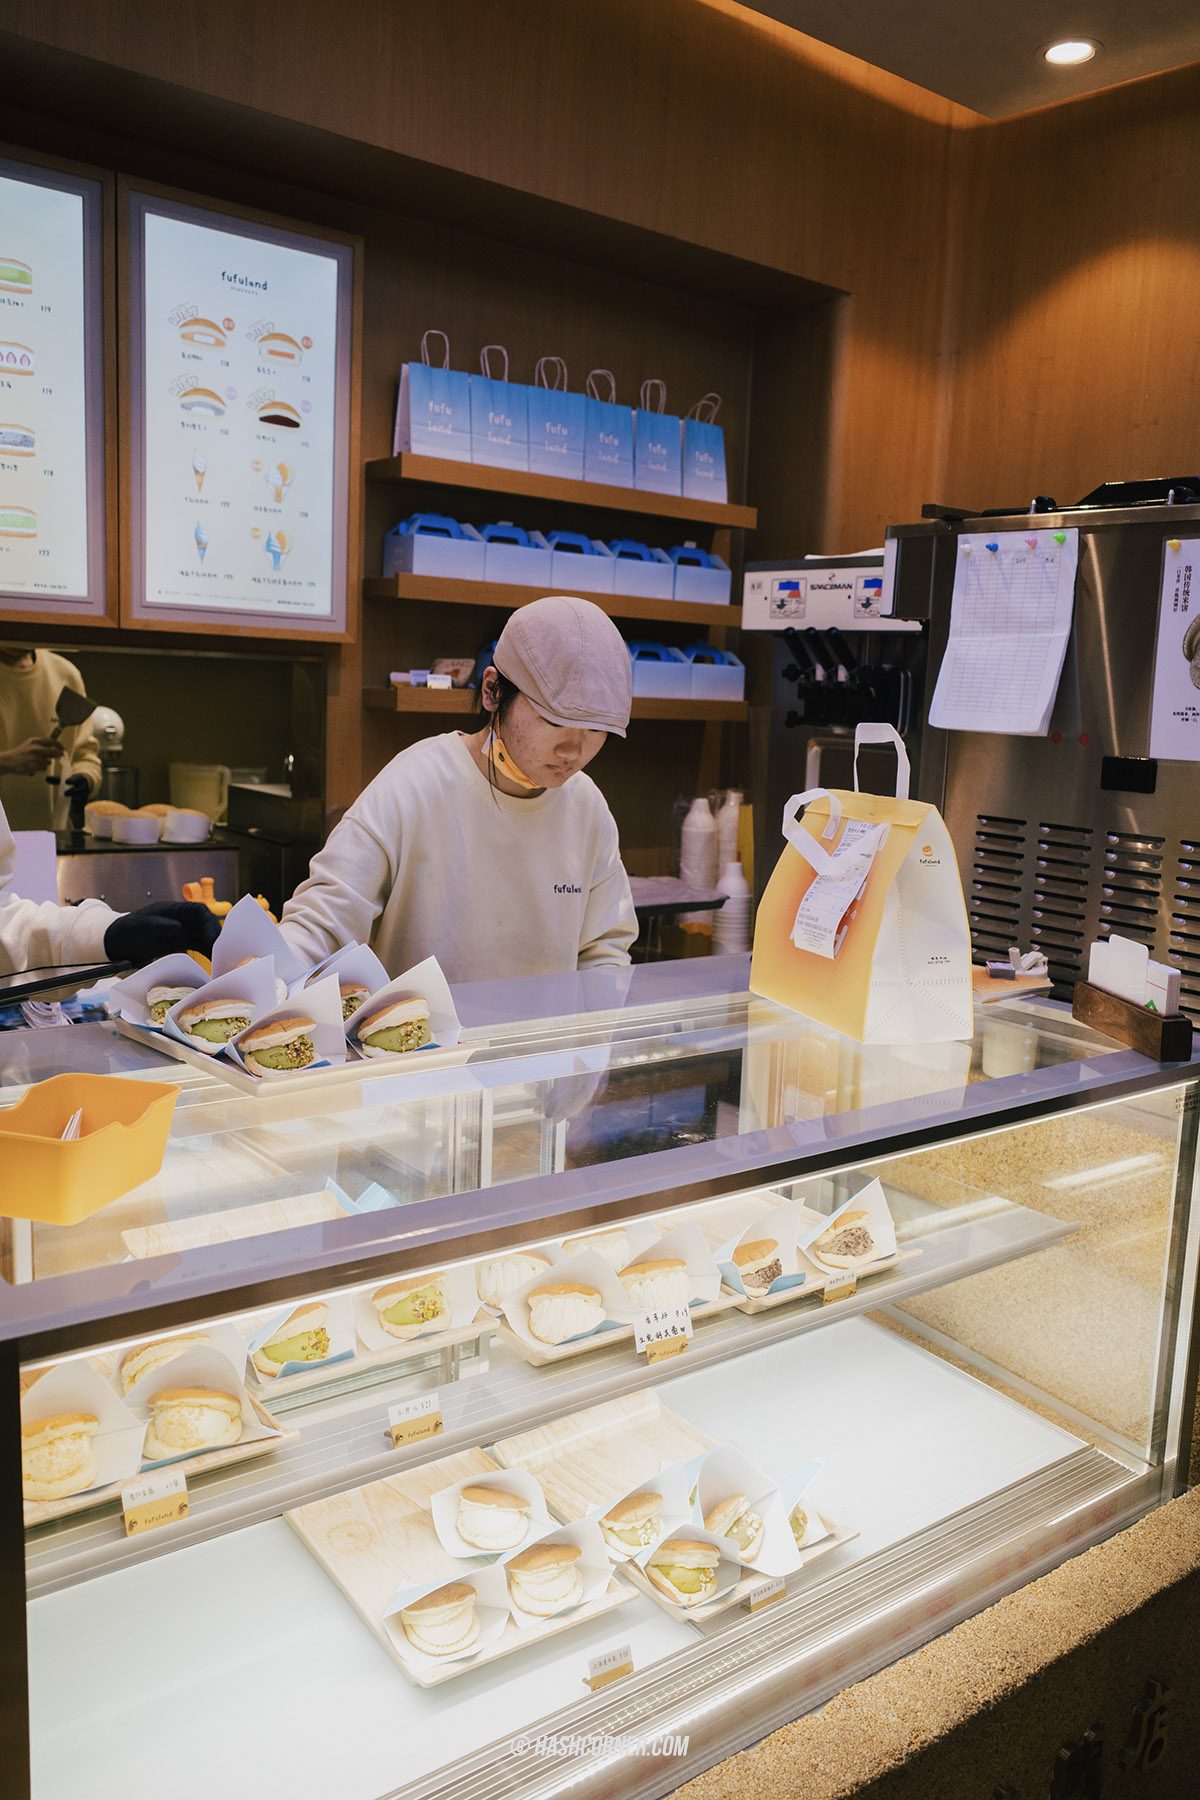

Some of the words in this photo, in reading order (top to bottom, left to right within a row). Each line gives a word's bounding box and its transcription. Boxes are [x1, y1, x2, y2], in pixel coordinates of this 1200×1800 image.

[221, 271, 268, 291] fufuland
[428, 400, 453, 416] fufu
[488, 412, 512, 427] fufu
[427, 420, 453, 435] land
[545, 421, 569, 437] fufu
[599, 432, 619, 446] fufu
[544, 439, 568, 455] land
[810, 583, 853, 591] SPACEMAN
[1181, 565, 1192, 612] 韩国传统米饼
[144, 1511, 173, 1525] fufuland
